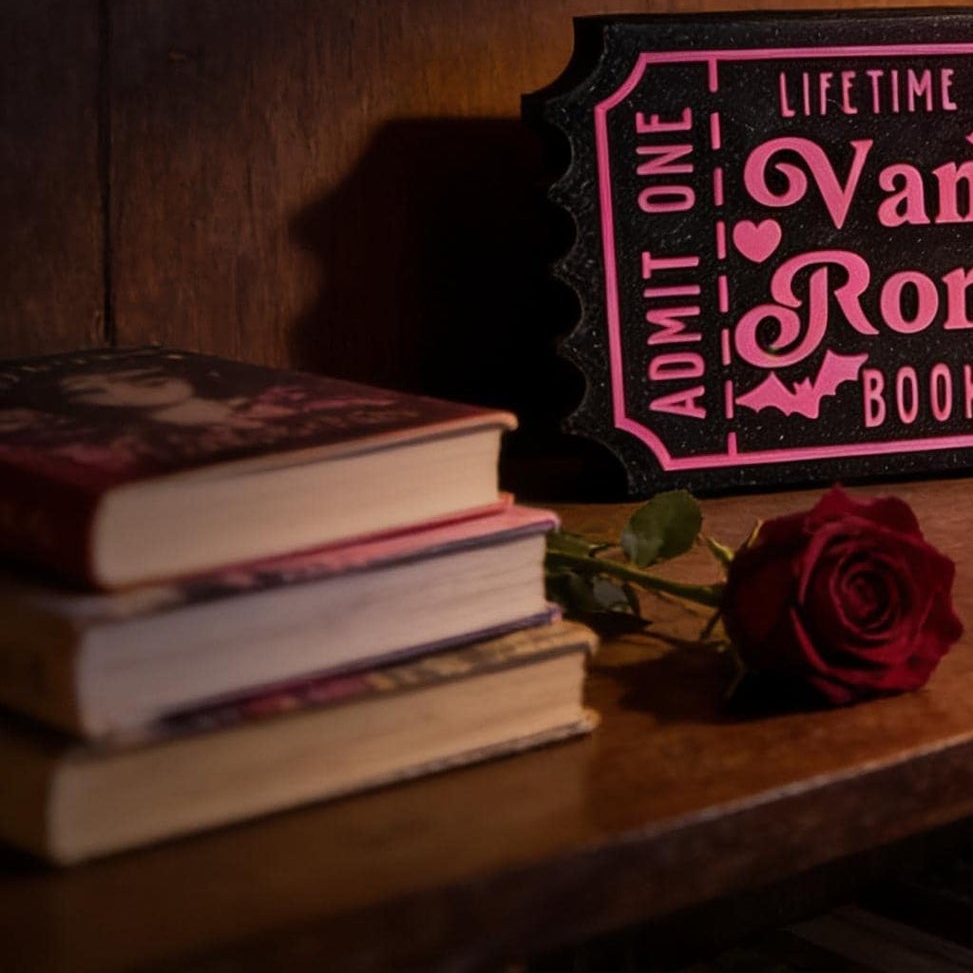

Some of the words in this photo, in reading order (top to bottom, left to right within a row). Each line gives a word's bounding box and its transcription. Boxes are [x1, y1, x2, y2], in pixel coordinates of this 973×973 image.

[779, 68, 958, 118] LIFETIME
[635, 107, 696, 214] ONE
[641, 251, 707, 419] ADMIT
